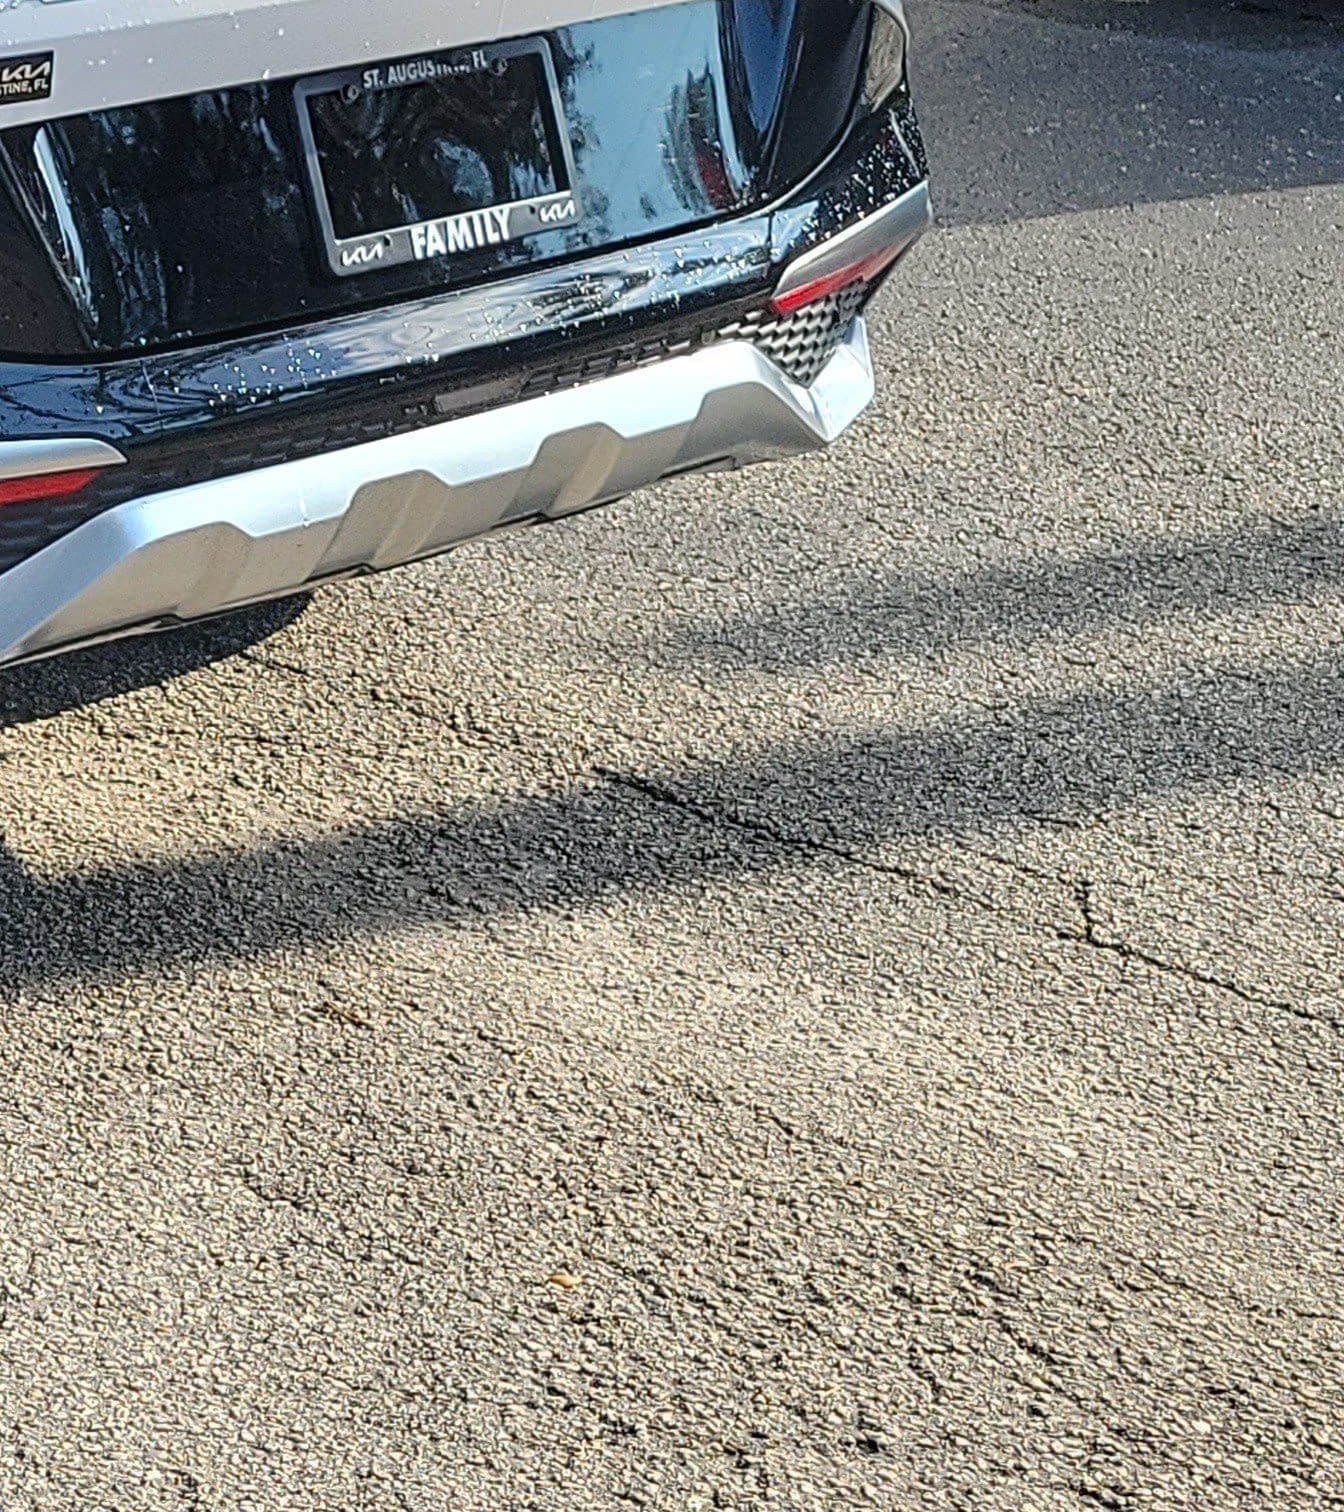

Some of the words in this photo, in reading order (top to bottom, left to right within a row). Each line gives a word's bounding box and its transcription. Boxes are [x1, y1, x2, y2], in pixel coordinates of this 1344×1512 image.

[1, 60, 51, 82] KIA
[363, 68, 384, 89] ST.
[34, 77, 49, 91] FL
[341, 240, 384, 267] KIA
[410, 205, 513, 261] FAMILY
[539, 199, 576, 223] KIA
